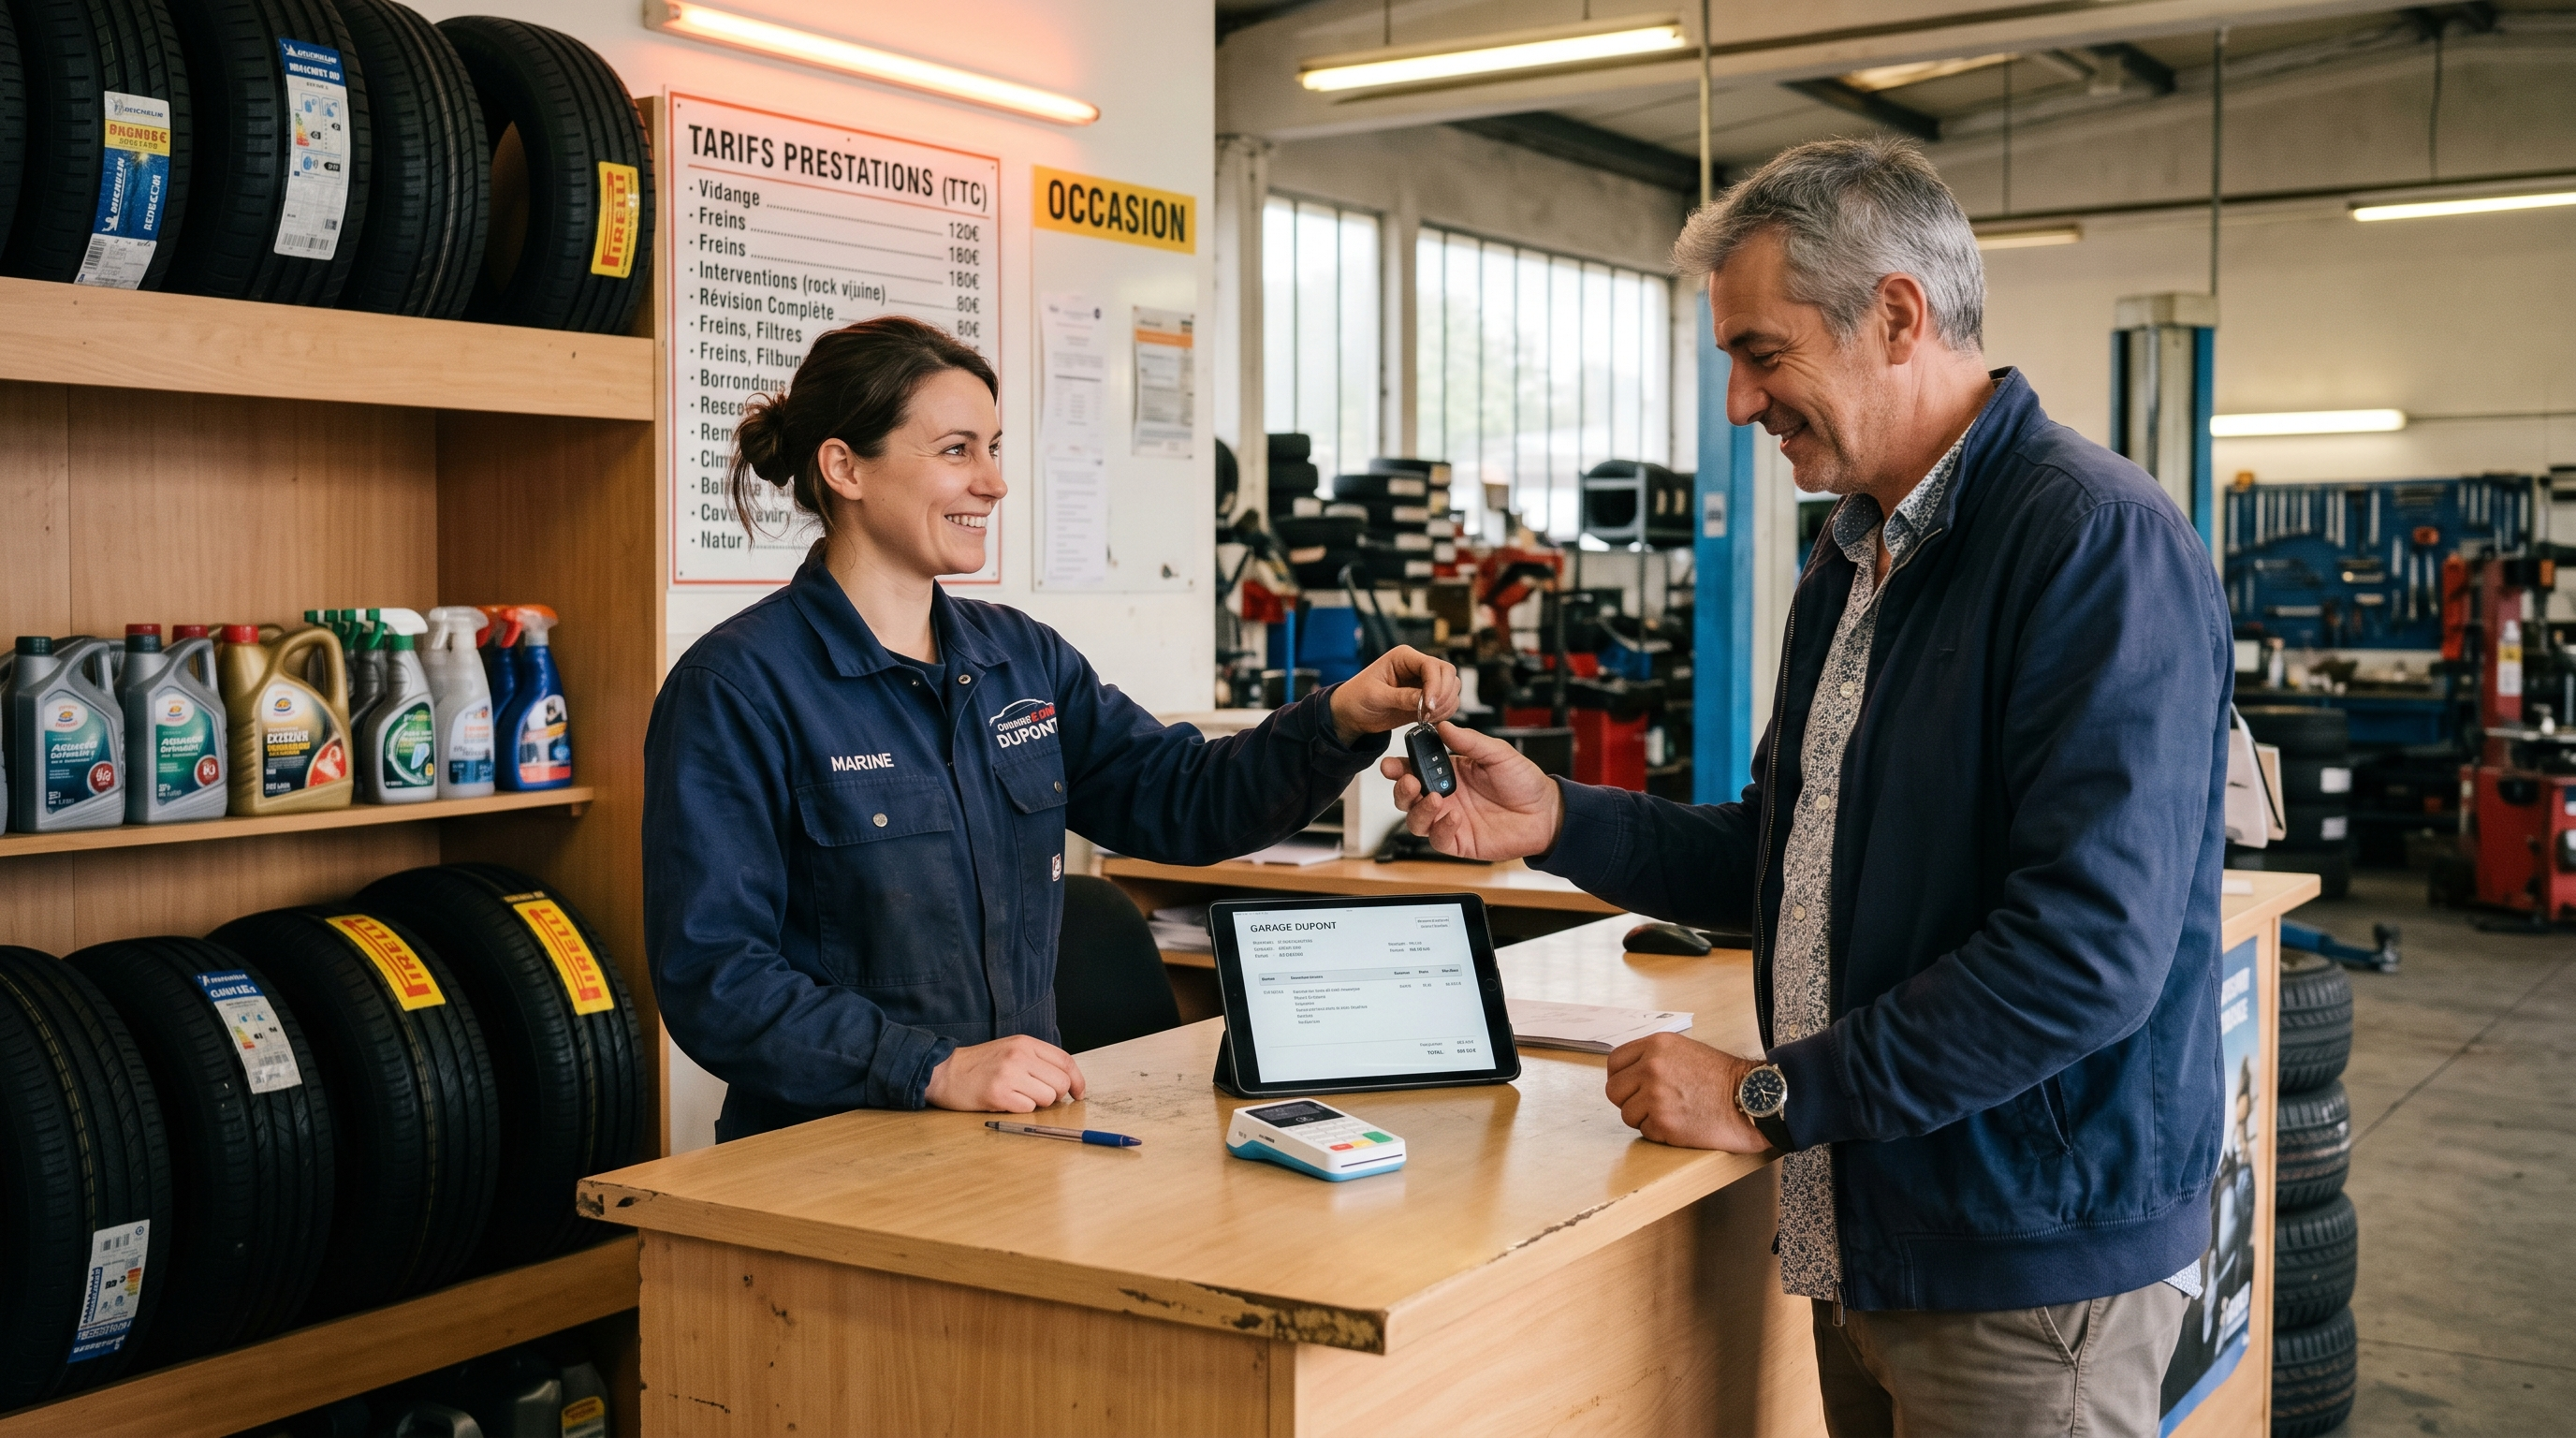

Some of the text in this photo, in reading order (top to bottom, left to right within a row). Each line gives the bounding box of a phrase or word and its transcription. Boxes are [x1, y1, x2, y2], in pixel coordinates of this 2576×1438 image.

[688, 124, 988, 213] TARIFS PRESTATIONS (TTC)
[600, 171, 625, 268] PIRELLI
[699, 179, 980, 242] Vidange 120€
[699, 207, 980, 266] Freins 180€
[1048, 179, 1185, 243] OCCASION
[699, 234, 980, 290] Freins 180€
[699, 260, 798, 290] Interventions
[802, 273, 838, 297] (rock
[956, 295, 980, 314] 80€
[700, 287, 980, 338] Révision Complète 80€
[700, 315, 802, 344] Freins, Filtres
[700, 342, 751, 367] Freins,
[701, 530, 743, 550] Natur
[830, 753, 895, 771] MARINE
[528, 907, 602, 1002] PIRELLI
[1250, 921, 1337, 932] GARAGE DUPONT
[340, 917, 432, 998] PIRELLI
